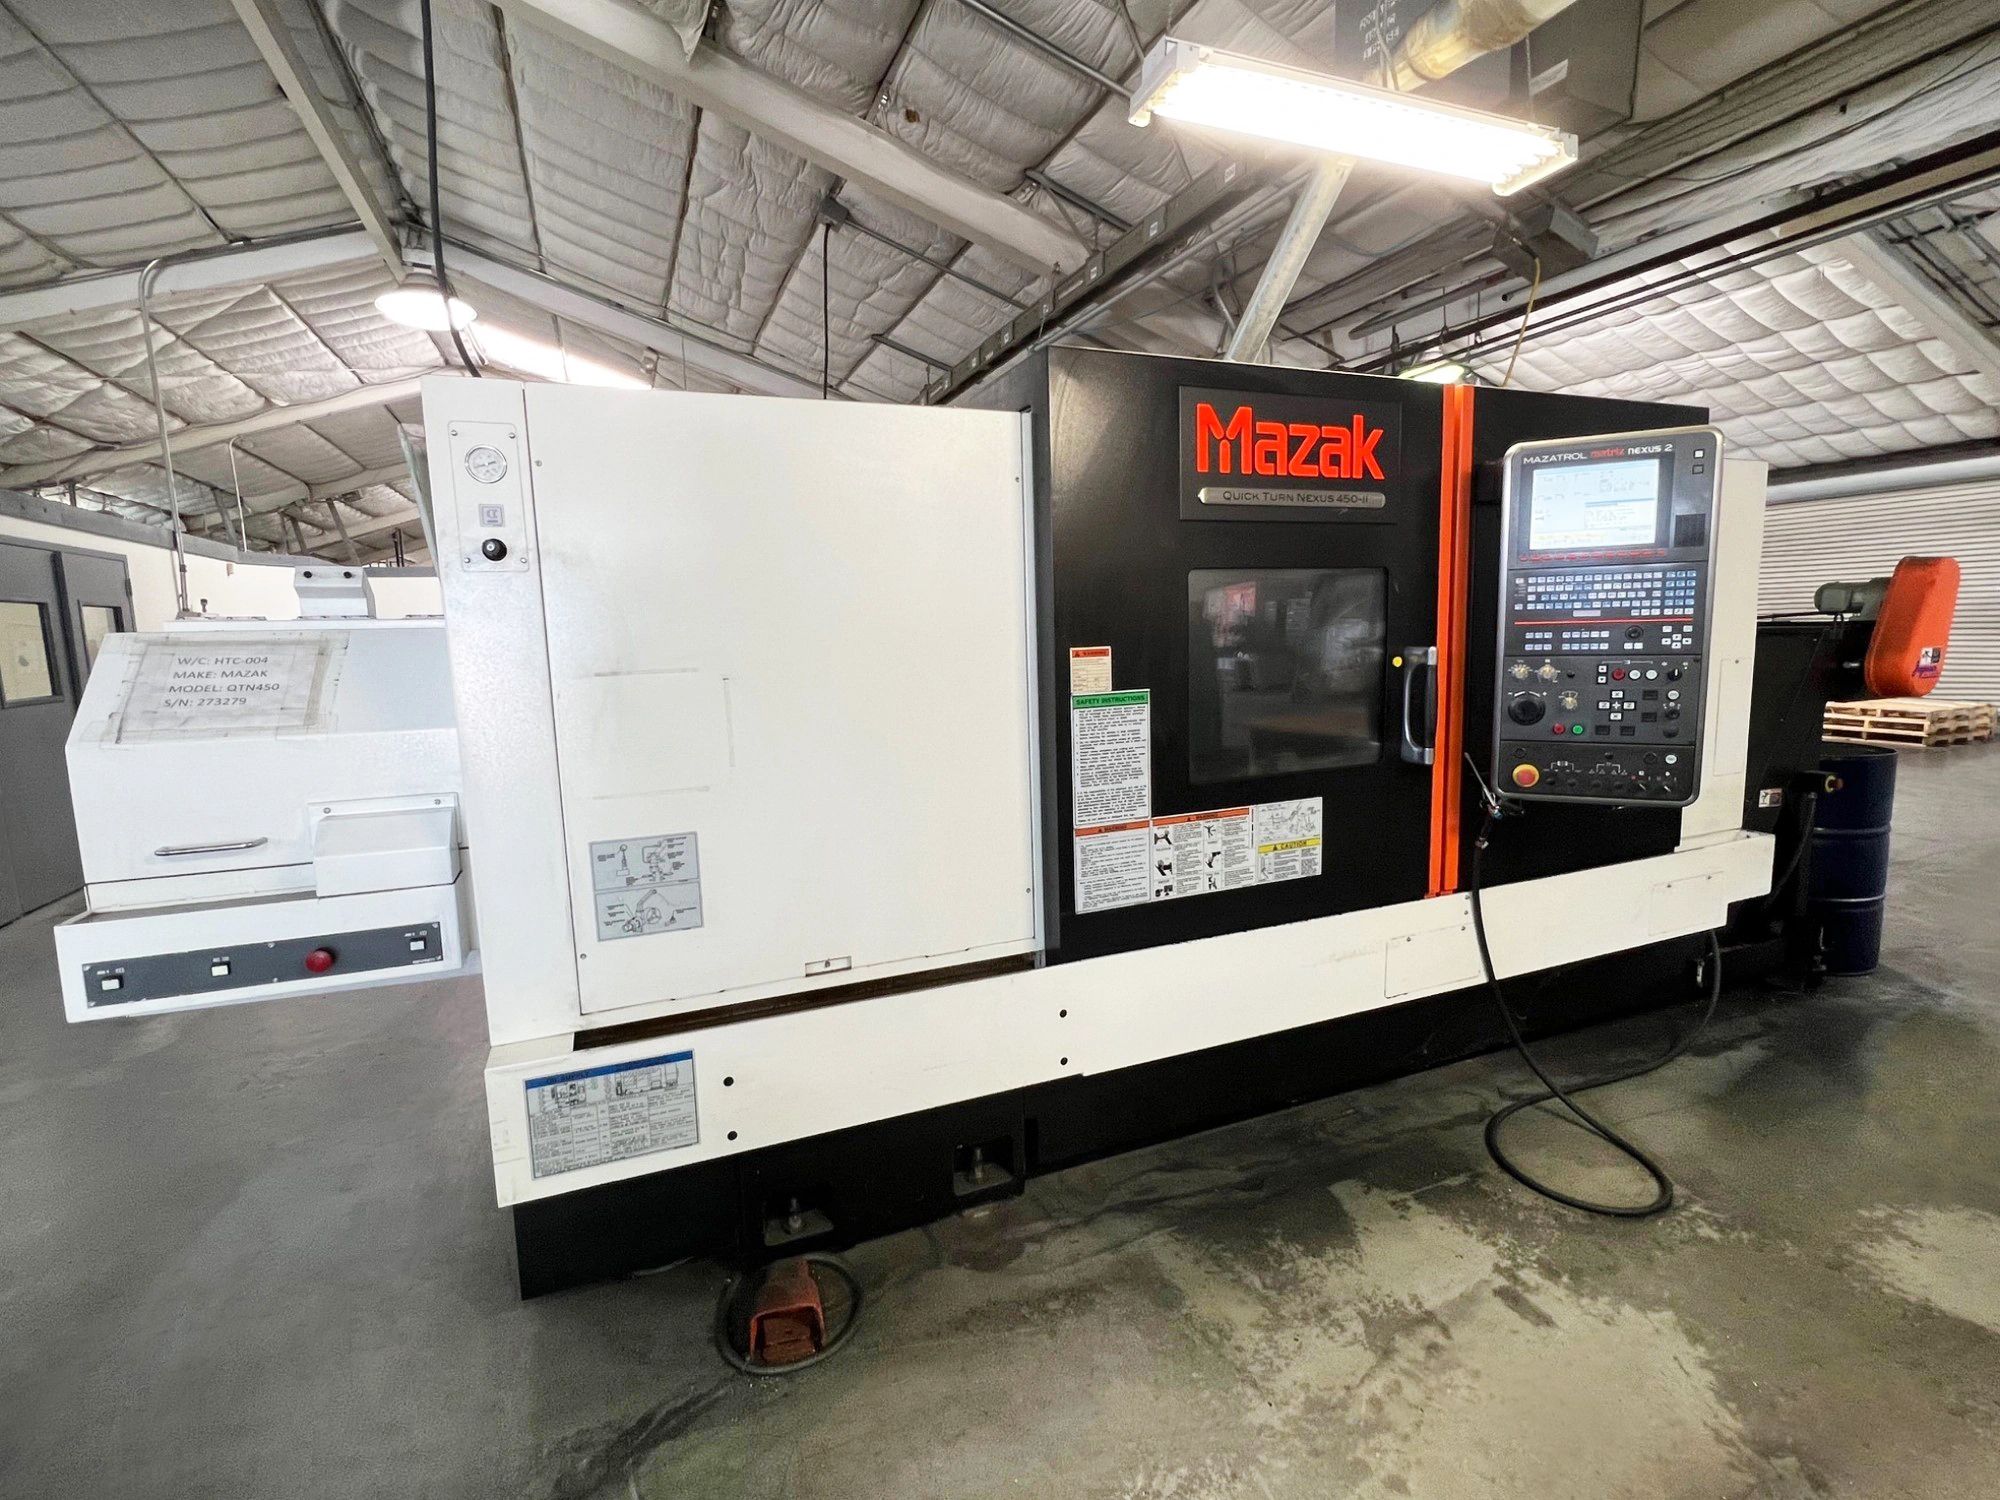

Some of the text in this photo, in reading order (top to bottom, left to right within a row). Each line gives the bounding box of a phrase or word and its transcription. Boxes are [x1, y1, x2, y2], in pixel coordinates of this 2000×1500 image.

[1196, 402, 1385, 480] Mazak
[1523, 452, 1588, 464] MAZATROL
[1590, 447, 1625, 459] matrix
[1665, 443, 1674, 452] 2
[177, 656, 269, 666] W/C: HTC-004
[173, 670, 269, 679] MAKE: MAZAK
[168, 683, 280, 693] MODEL: QTN450
[163, 697, 247, 708] S/N: 273279
[1076, 695, 1145, 705] SAFETY INSTRUCTIONS
[1280, 840, 1307, 850] CAUTION
